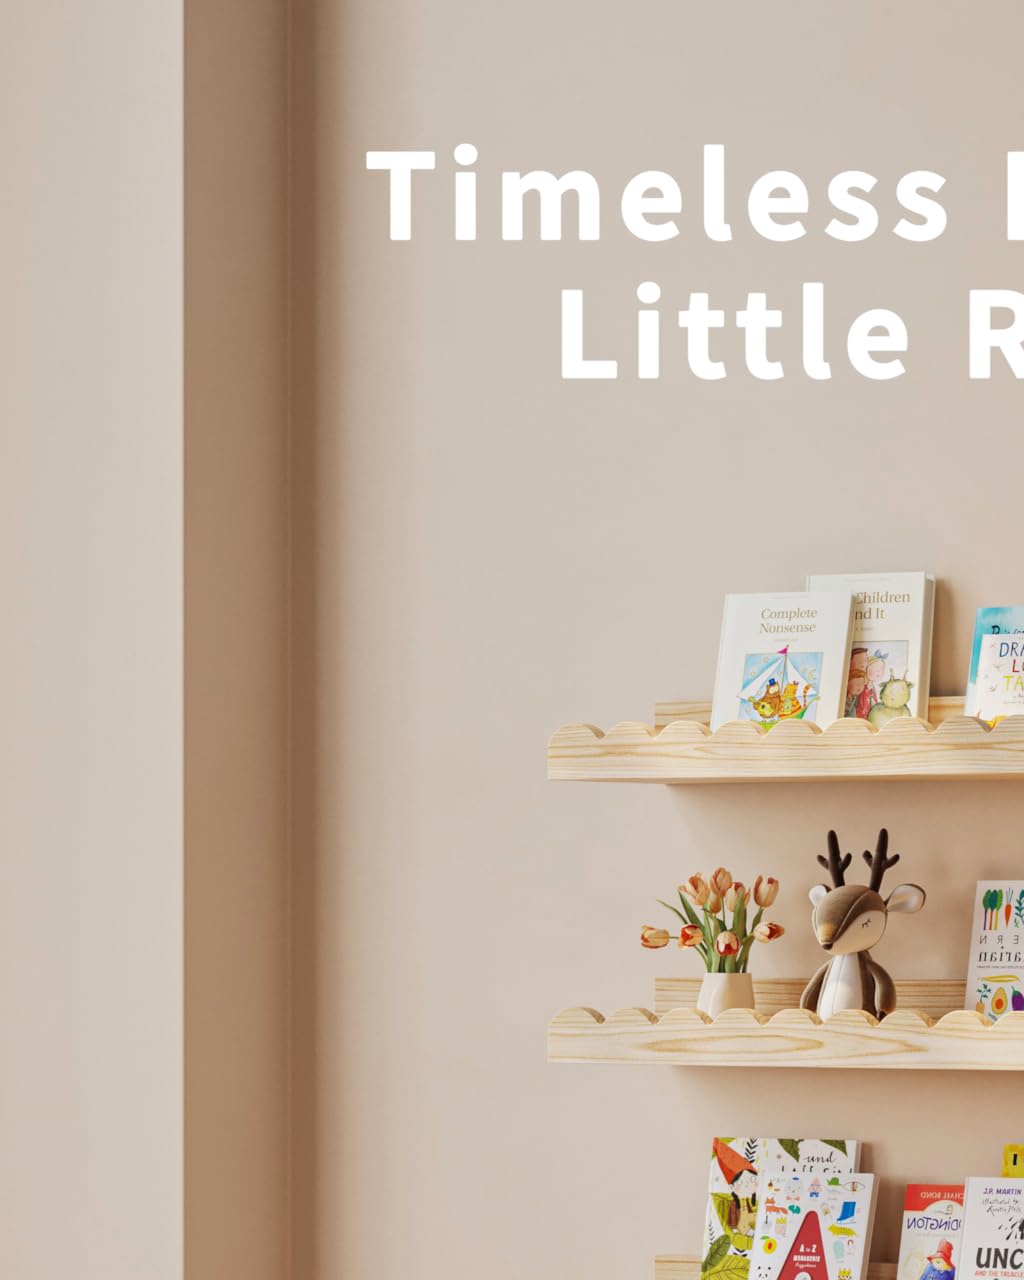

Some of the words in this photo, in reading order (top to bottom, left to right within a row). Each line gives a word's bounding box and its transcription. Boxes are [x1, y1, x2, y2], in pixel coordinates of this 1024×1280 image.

[761, 608, 818, 622] Complete
[759, 623, 816, 634] Nonsense
[803, 1150, 837, 1163] und
[1012, 1154, 1018, 1166] I
